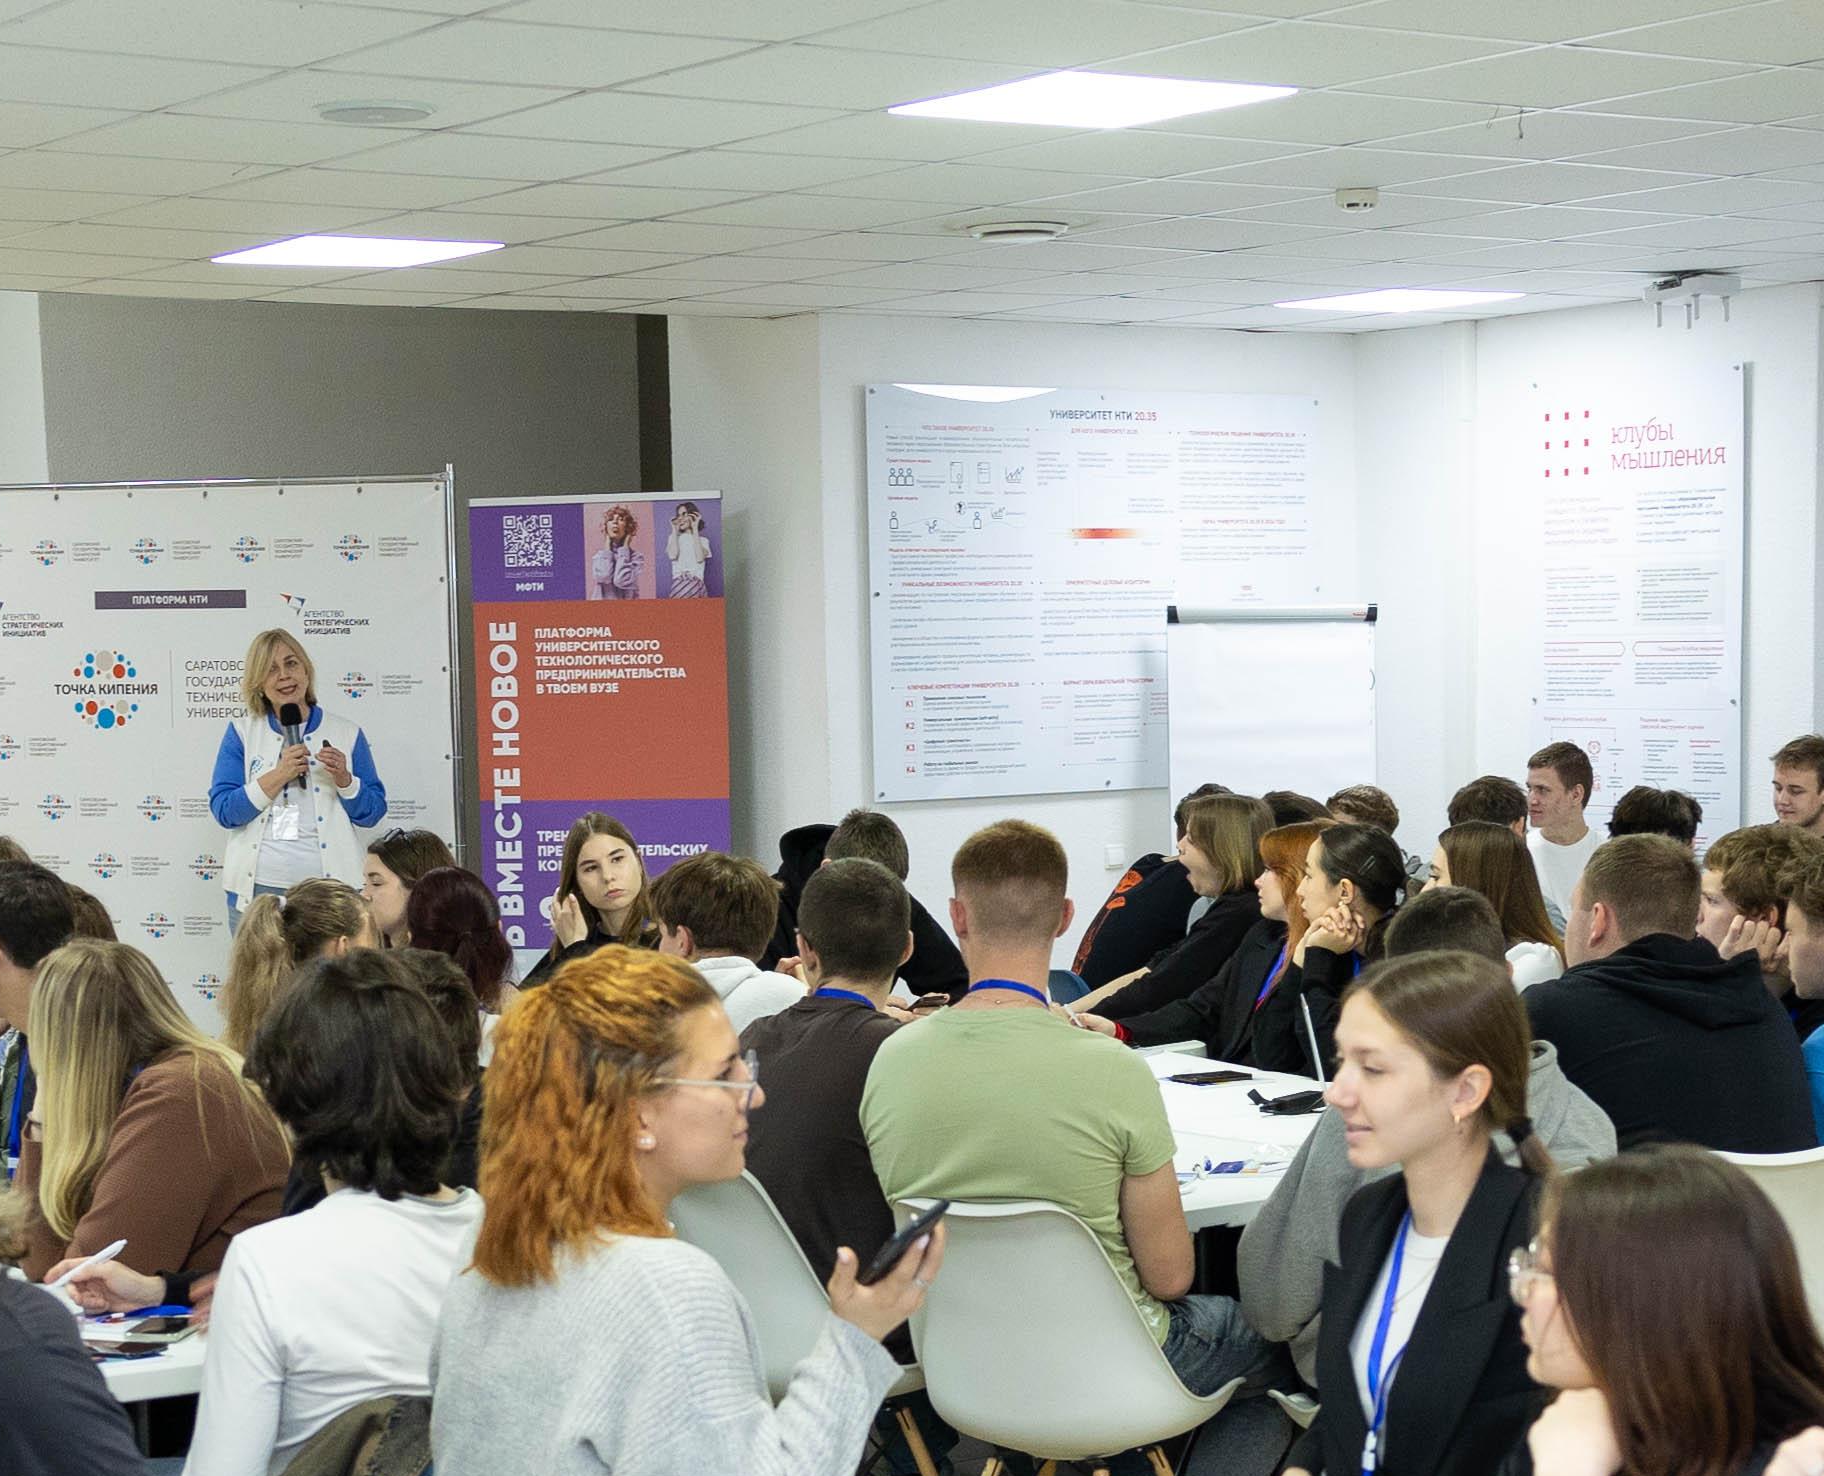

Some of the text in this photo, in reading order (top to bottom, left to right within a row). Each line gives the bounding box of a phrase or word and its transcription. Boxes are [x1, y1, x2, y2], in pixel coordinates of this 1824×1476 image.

[1049, 408, 1158, 421] УНИВЕРСИТЕТ НТИ 20.35
[1611, 416, 1674, 449] клубы
[1611, 447, 1726, 470] мышления
[515, 582, 544, 592] МФТИ
[132, 594, 209, 605] ПЛАТФОРМА НТИ
[304, 610, 344, 618] АГЕНТСТВО
[2, 621, 64, 629] СТРАТЕГИЧЕСКИХ
[304, 619, 370, 627] СТРАТЕГИЧЕСКИХ
[304, 627, 351, 635] ИНИЦИАТИВ
[534, 626, 612, 639] ПЛАТФОРМА
[534, 640, 660, 652] УНИВЕРСИТЕТСКОГО
[534, 653, 664, 666] ТЕХНОЛОГИЧЕСКОГО
[535, 667, 687, 682] ПРЕДПРИНИМАТЕЛЬСТВА
[54, 683, 158, 695] ТОЧКА КИПЕНИЯ
[488, 621, 520, 756] НОВОЕ
[536, 683, 619, 694] В ТВОЕМ ВУЗЕ
[187, 707, 248, 719] УНИВЕРСИ
[492, 767, 525, 917] ВМЕСТЕ
[537, 830, 569, 842] ТРЕН
